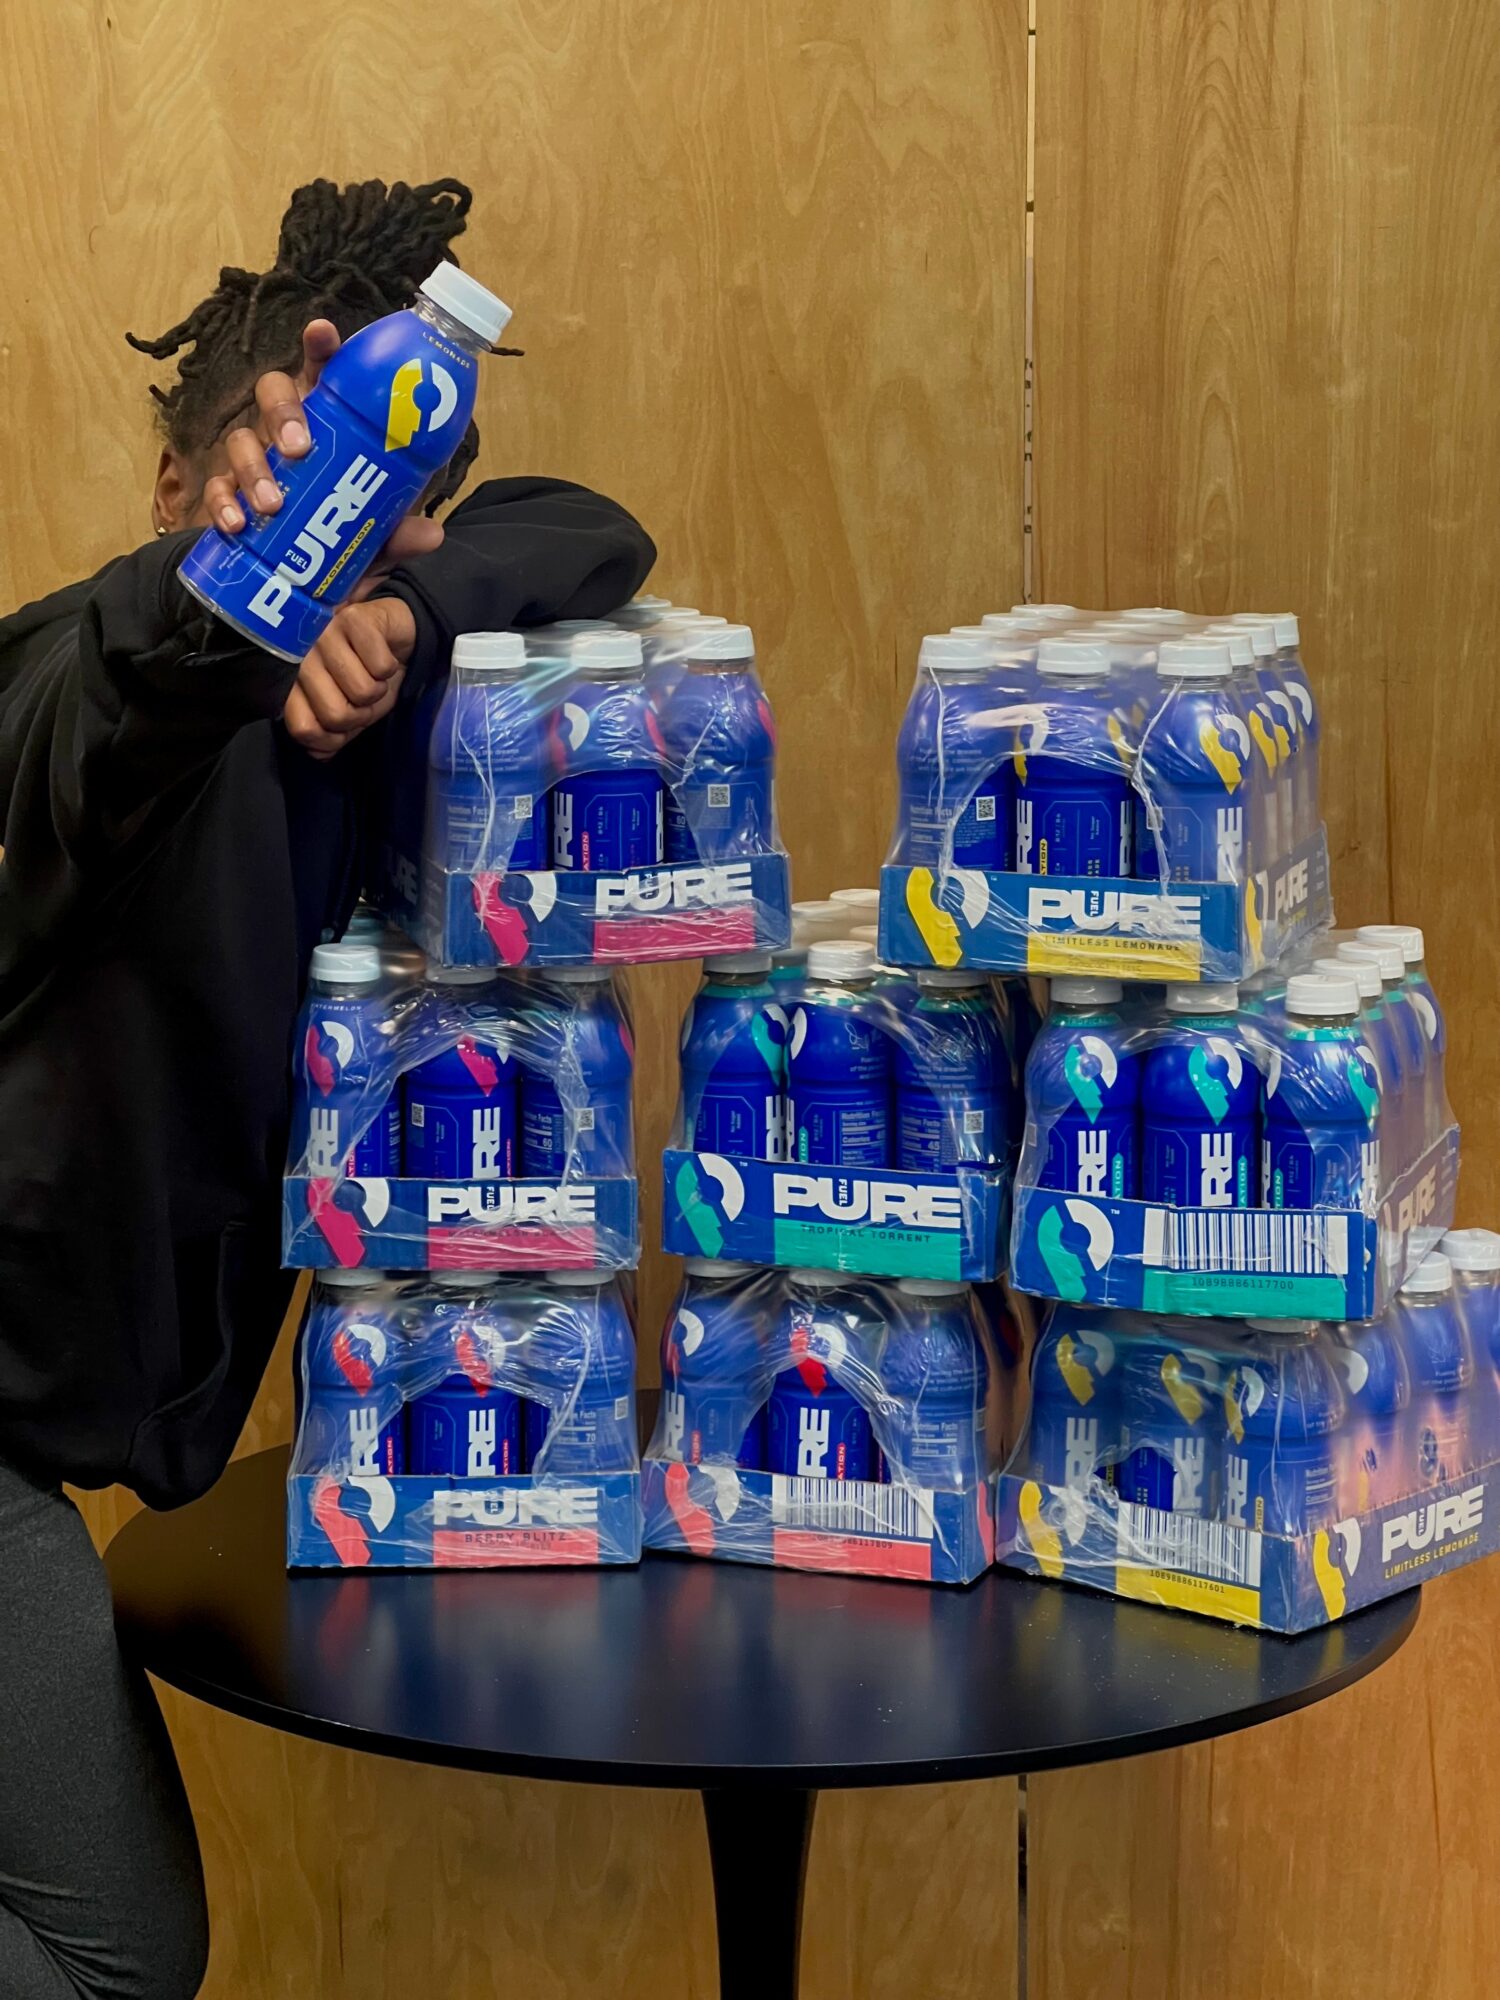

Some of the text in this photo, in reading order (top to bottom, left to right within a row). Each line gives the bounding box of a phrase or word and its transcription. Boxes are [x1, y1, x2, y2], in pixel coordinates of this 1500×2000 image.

[247, 453, 389, 628] PURE
[285, 549, 308, 570] FUEL
[316, 522, 372, 598] HYDRATION
[554, 790, 574, 868] RE
[1017, 799, 1033, 875] RE
[1217, 807, 1243, 883] RE
[595, 862, 752, 915] PURE
[1029, 887, 1201, 935] PURE
[1090, 890, 1099, 917] FUEL
[310, 1107, 339, 1178] RE
[473, 1107, 500, 1178] RE
[1078, 1130, 1107, 1197] RE
[1201, 1132, 1232, 1207] RE
[428, 1186, 596, 1223] PURE
[773, 1172, 961, 1229] PURE
[839, 1179, 847, 1205] FUEL
[801, 1224, 931, 1243] TROPICAL TORRENT
[349, 1407, 380, 1476] RE
[468, 1409, 496, 1477] RE
[798, 1407, 830, 1478] RE
[1173, 1437, 1205, 1510] RE
[433, 1488, 598, 1525] PURE
[1227, 1454, 1248, 1527] RE
[1382, 1484, 1484, 1563] PURE
[523, 1532, 567, 1542] BLITZ
[1384, 1531, 1480, 1579] LIMITLESS LEMONADE
[1150, 1569, 1225, 1594] 10898886117601
